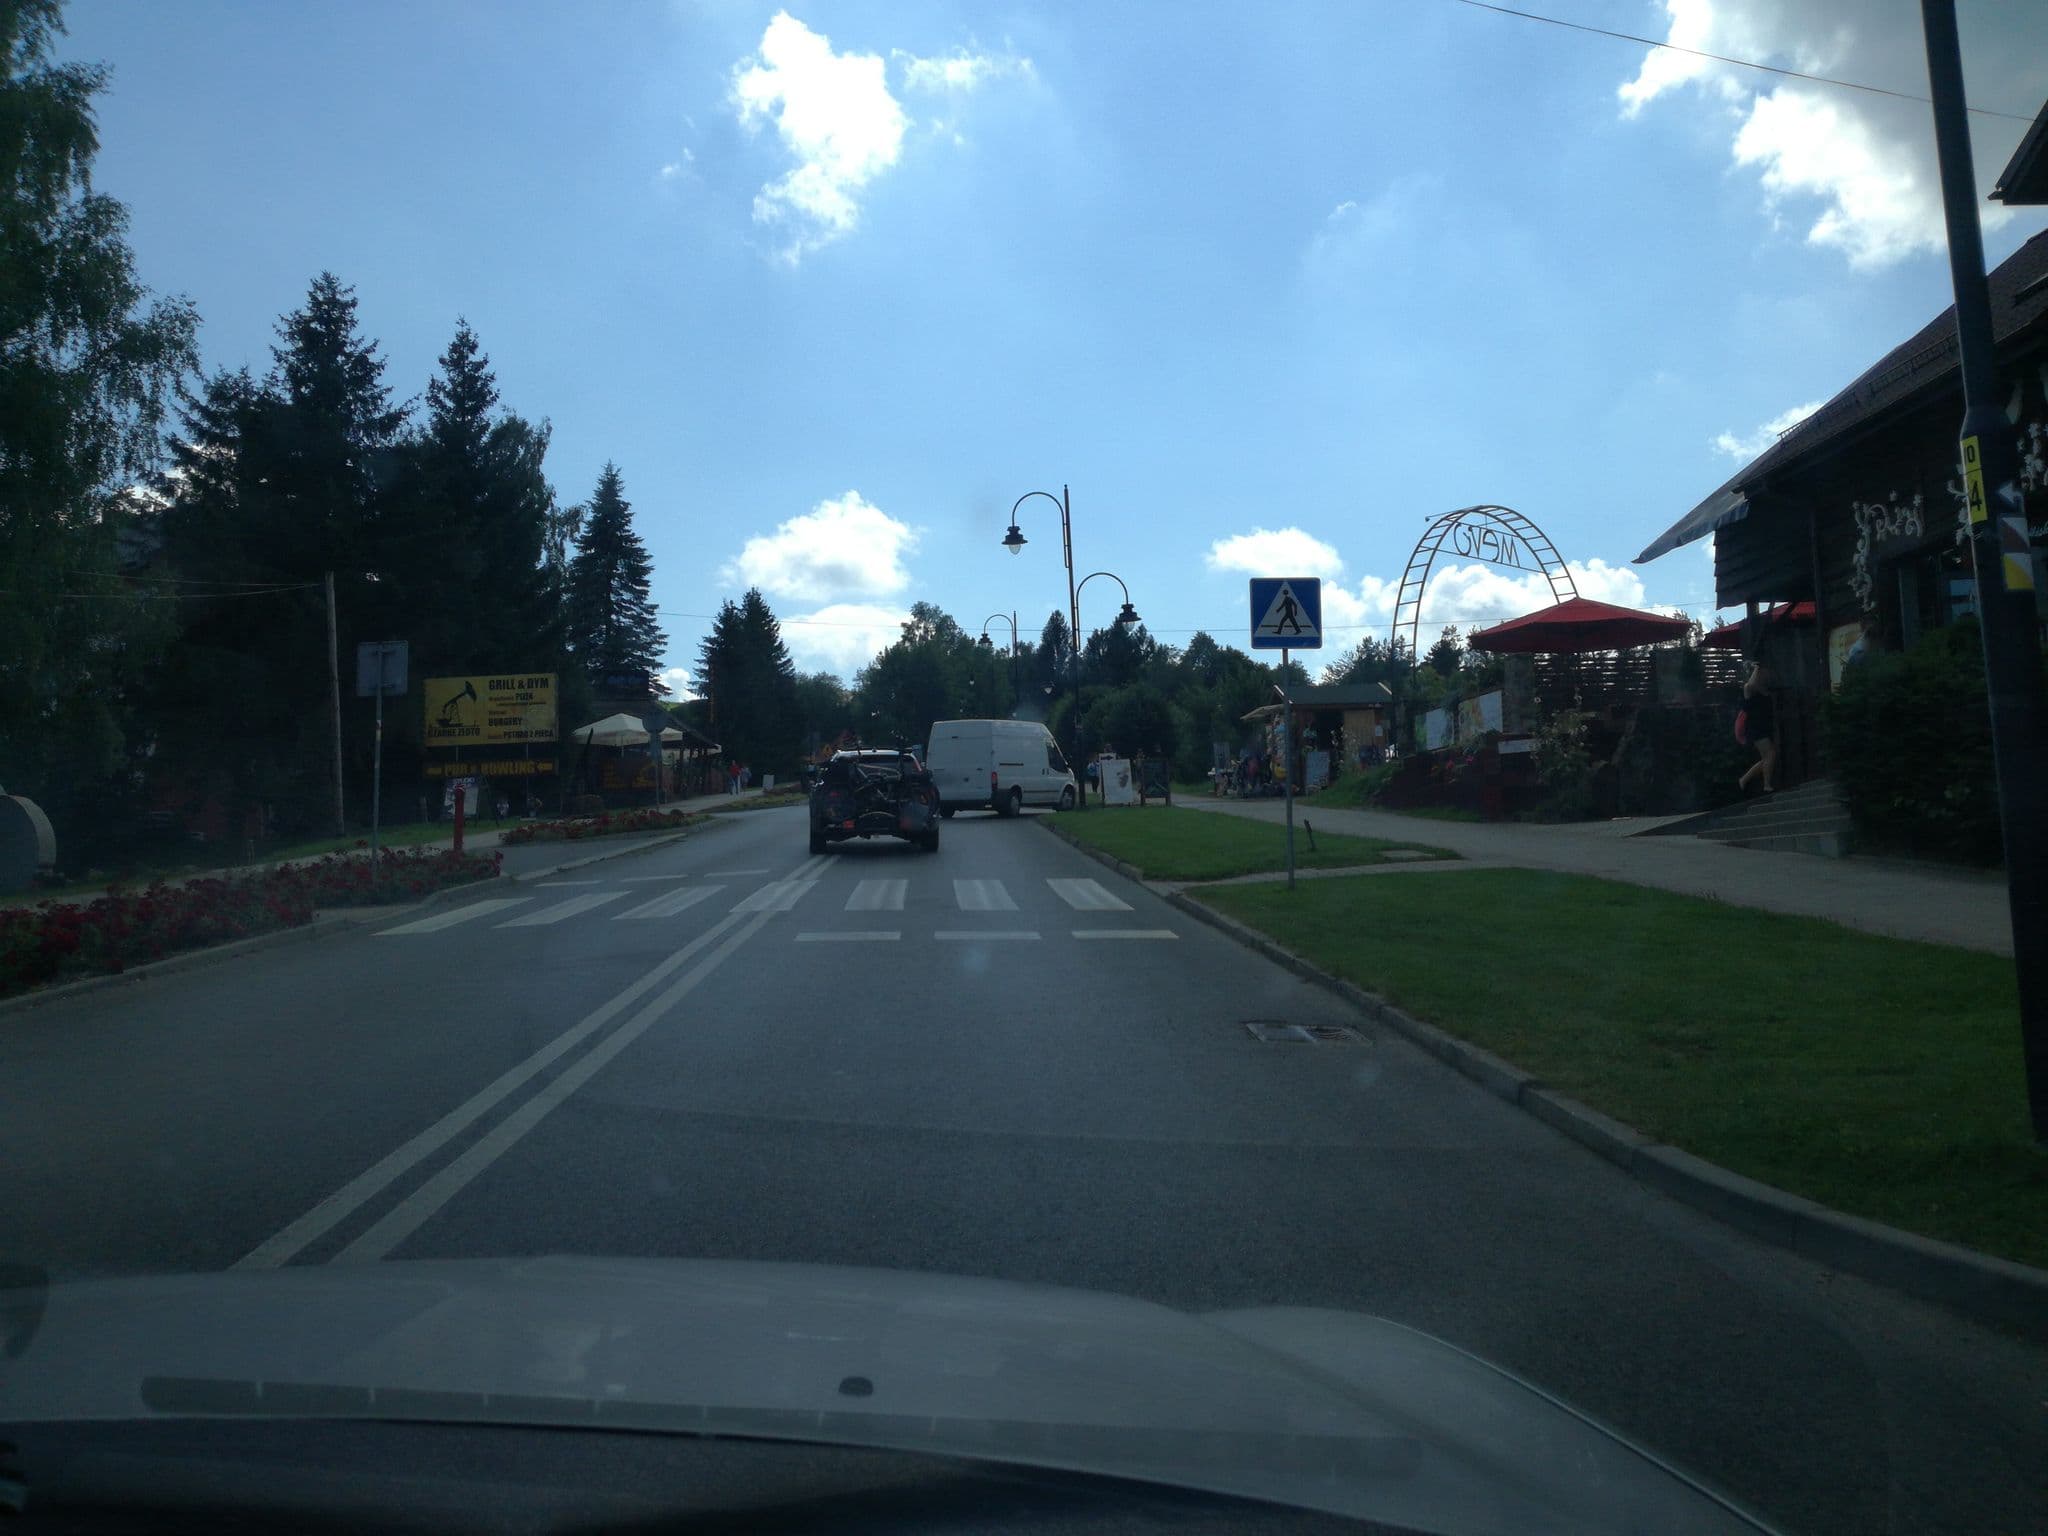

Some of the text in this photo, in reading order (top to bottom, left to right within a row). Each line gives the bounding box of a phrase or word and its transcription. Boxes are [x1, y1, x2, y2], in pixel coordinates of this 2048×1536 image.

[1971, 481, 1982, 510] 4
[489, 677, 549, 691] GRILL & DYM
[480, 760, 536, 776] BOWLING
